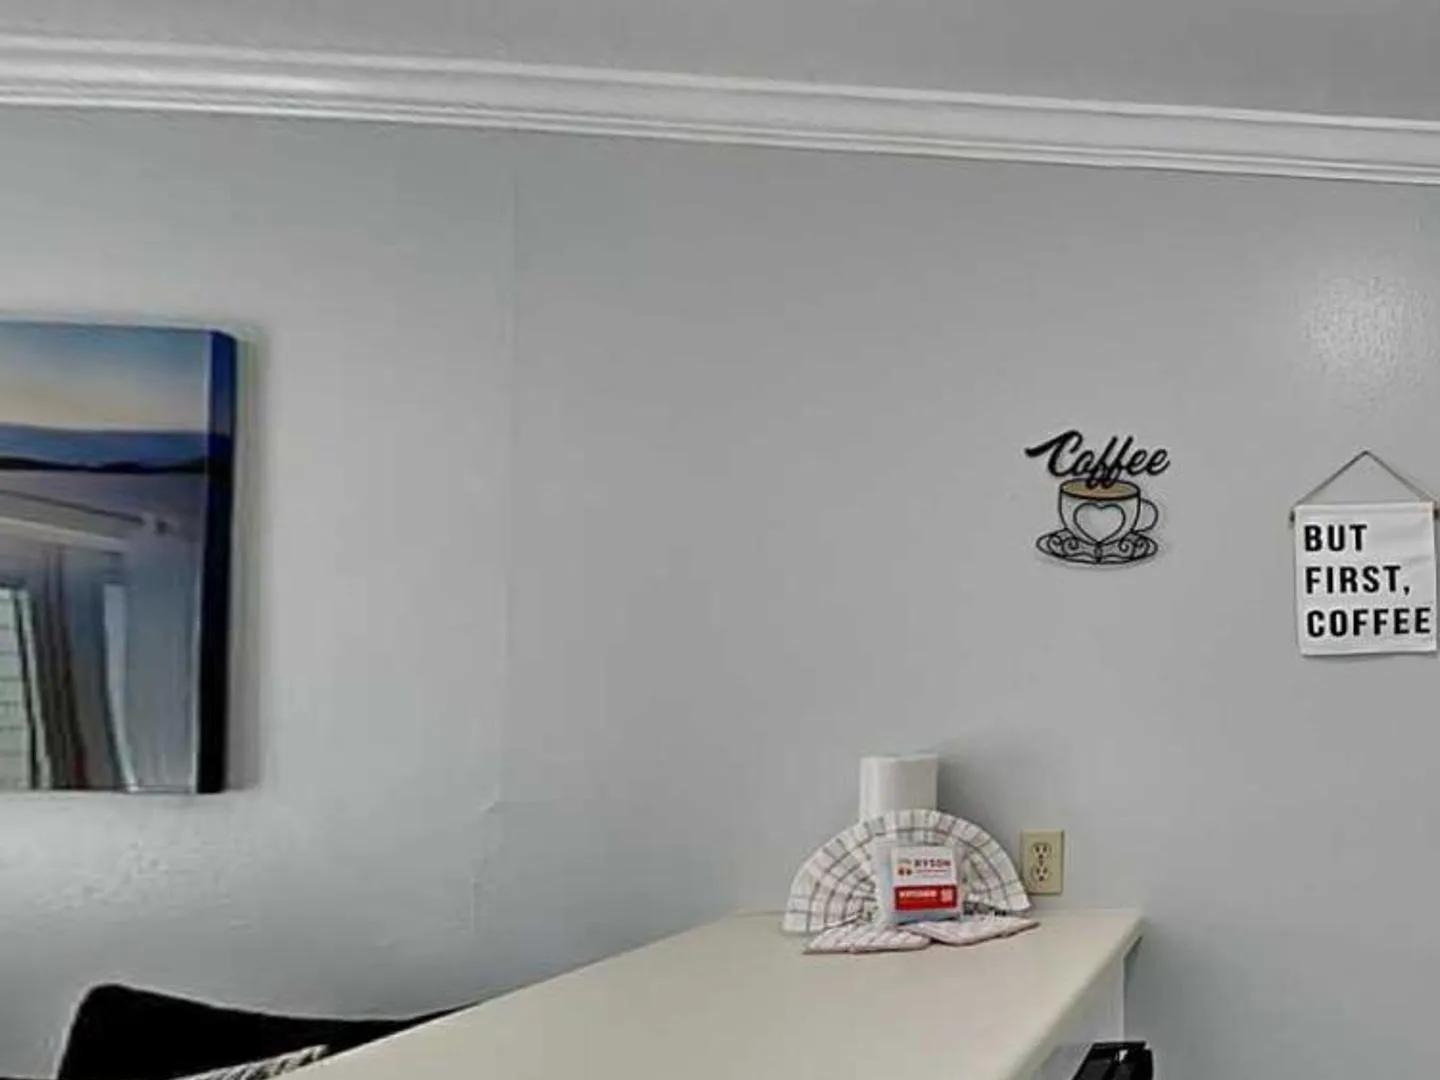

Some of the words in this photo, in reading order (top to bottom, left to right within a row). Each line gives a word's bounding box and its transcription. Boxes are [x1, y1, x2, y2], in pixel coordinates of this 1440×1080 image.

[1025, 429, 1171, 489] Coffee
[1304, 523, 1368, 552] BUT
[1305, 564, 1411, 596] FIRST,
[1306, 606, 1432, 638] COFFEE
